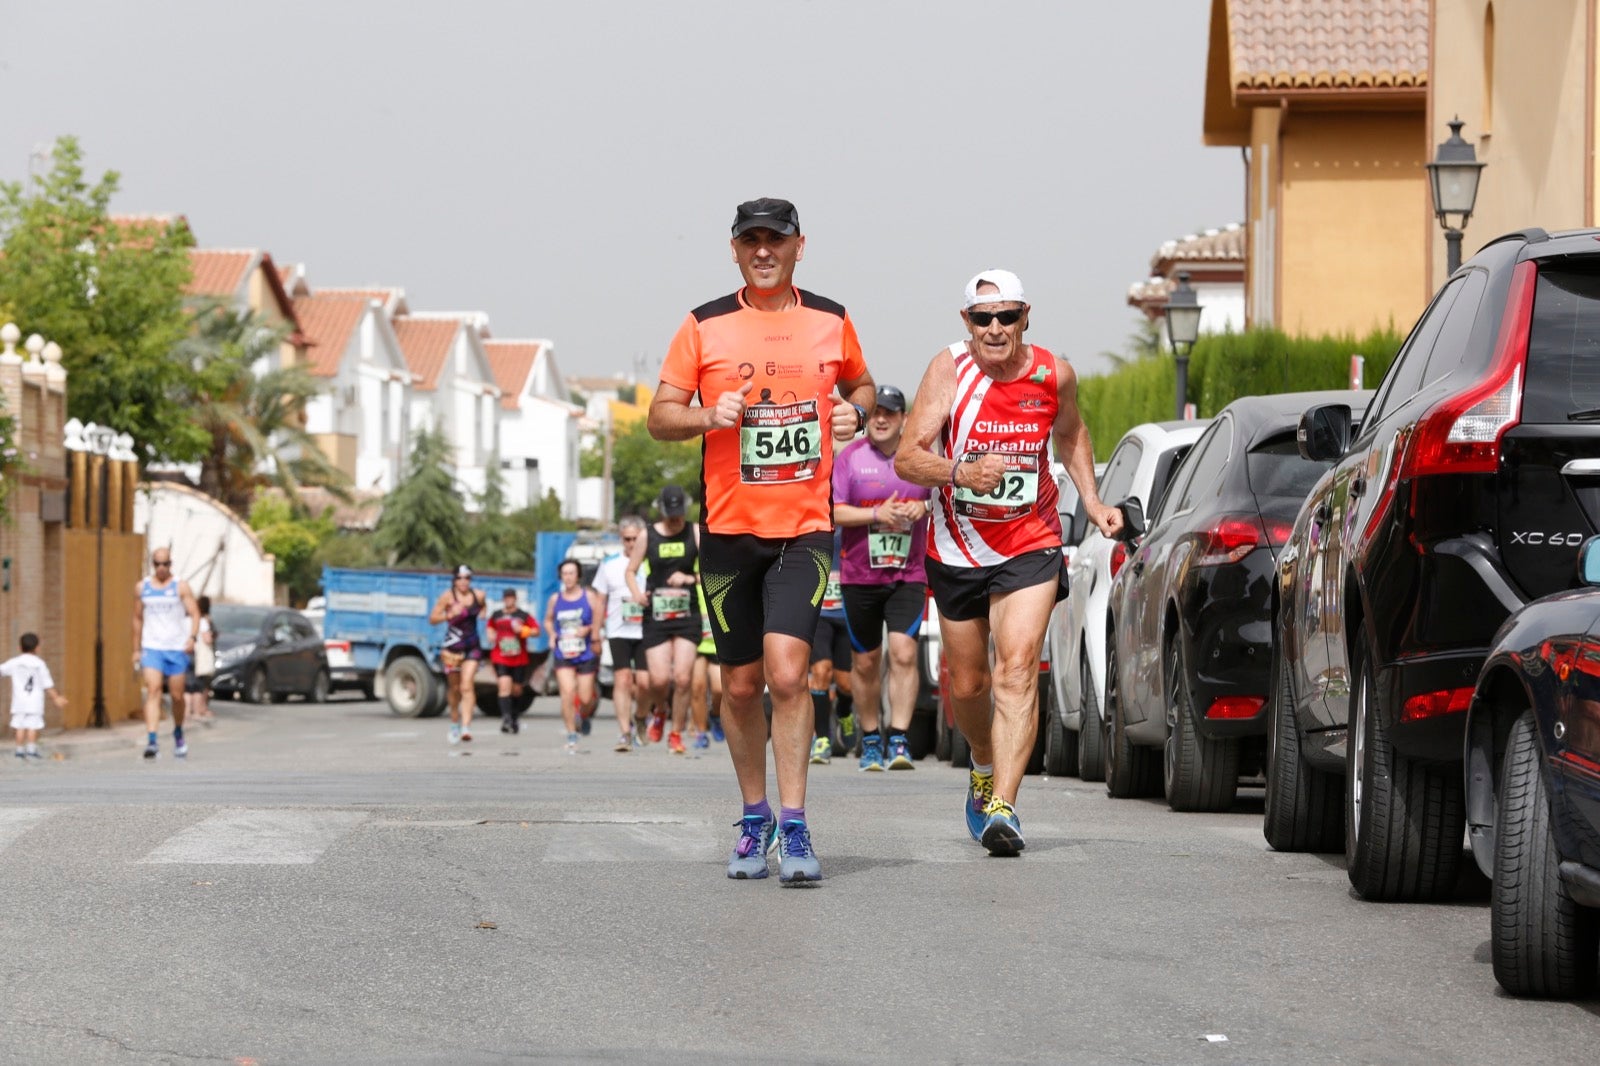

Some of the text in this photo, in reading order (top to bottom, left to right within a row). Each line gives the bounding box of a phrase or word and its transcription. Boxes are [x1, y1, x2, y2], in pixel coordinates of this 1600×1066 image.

[759, 408, 775, 418] GRAN
[792, 406, 798, 415] DE
[755, 427, 811, 459] 546
[966, 438, 1044, 452] Polisalud
[970, 475, 1025, 501] 02
[879, 535, 903, 552] 171
[24, 675, 34, 693] 4
